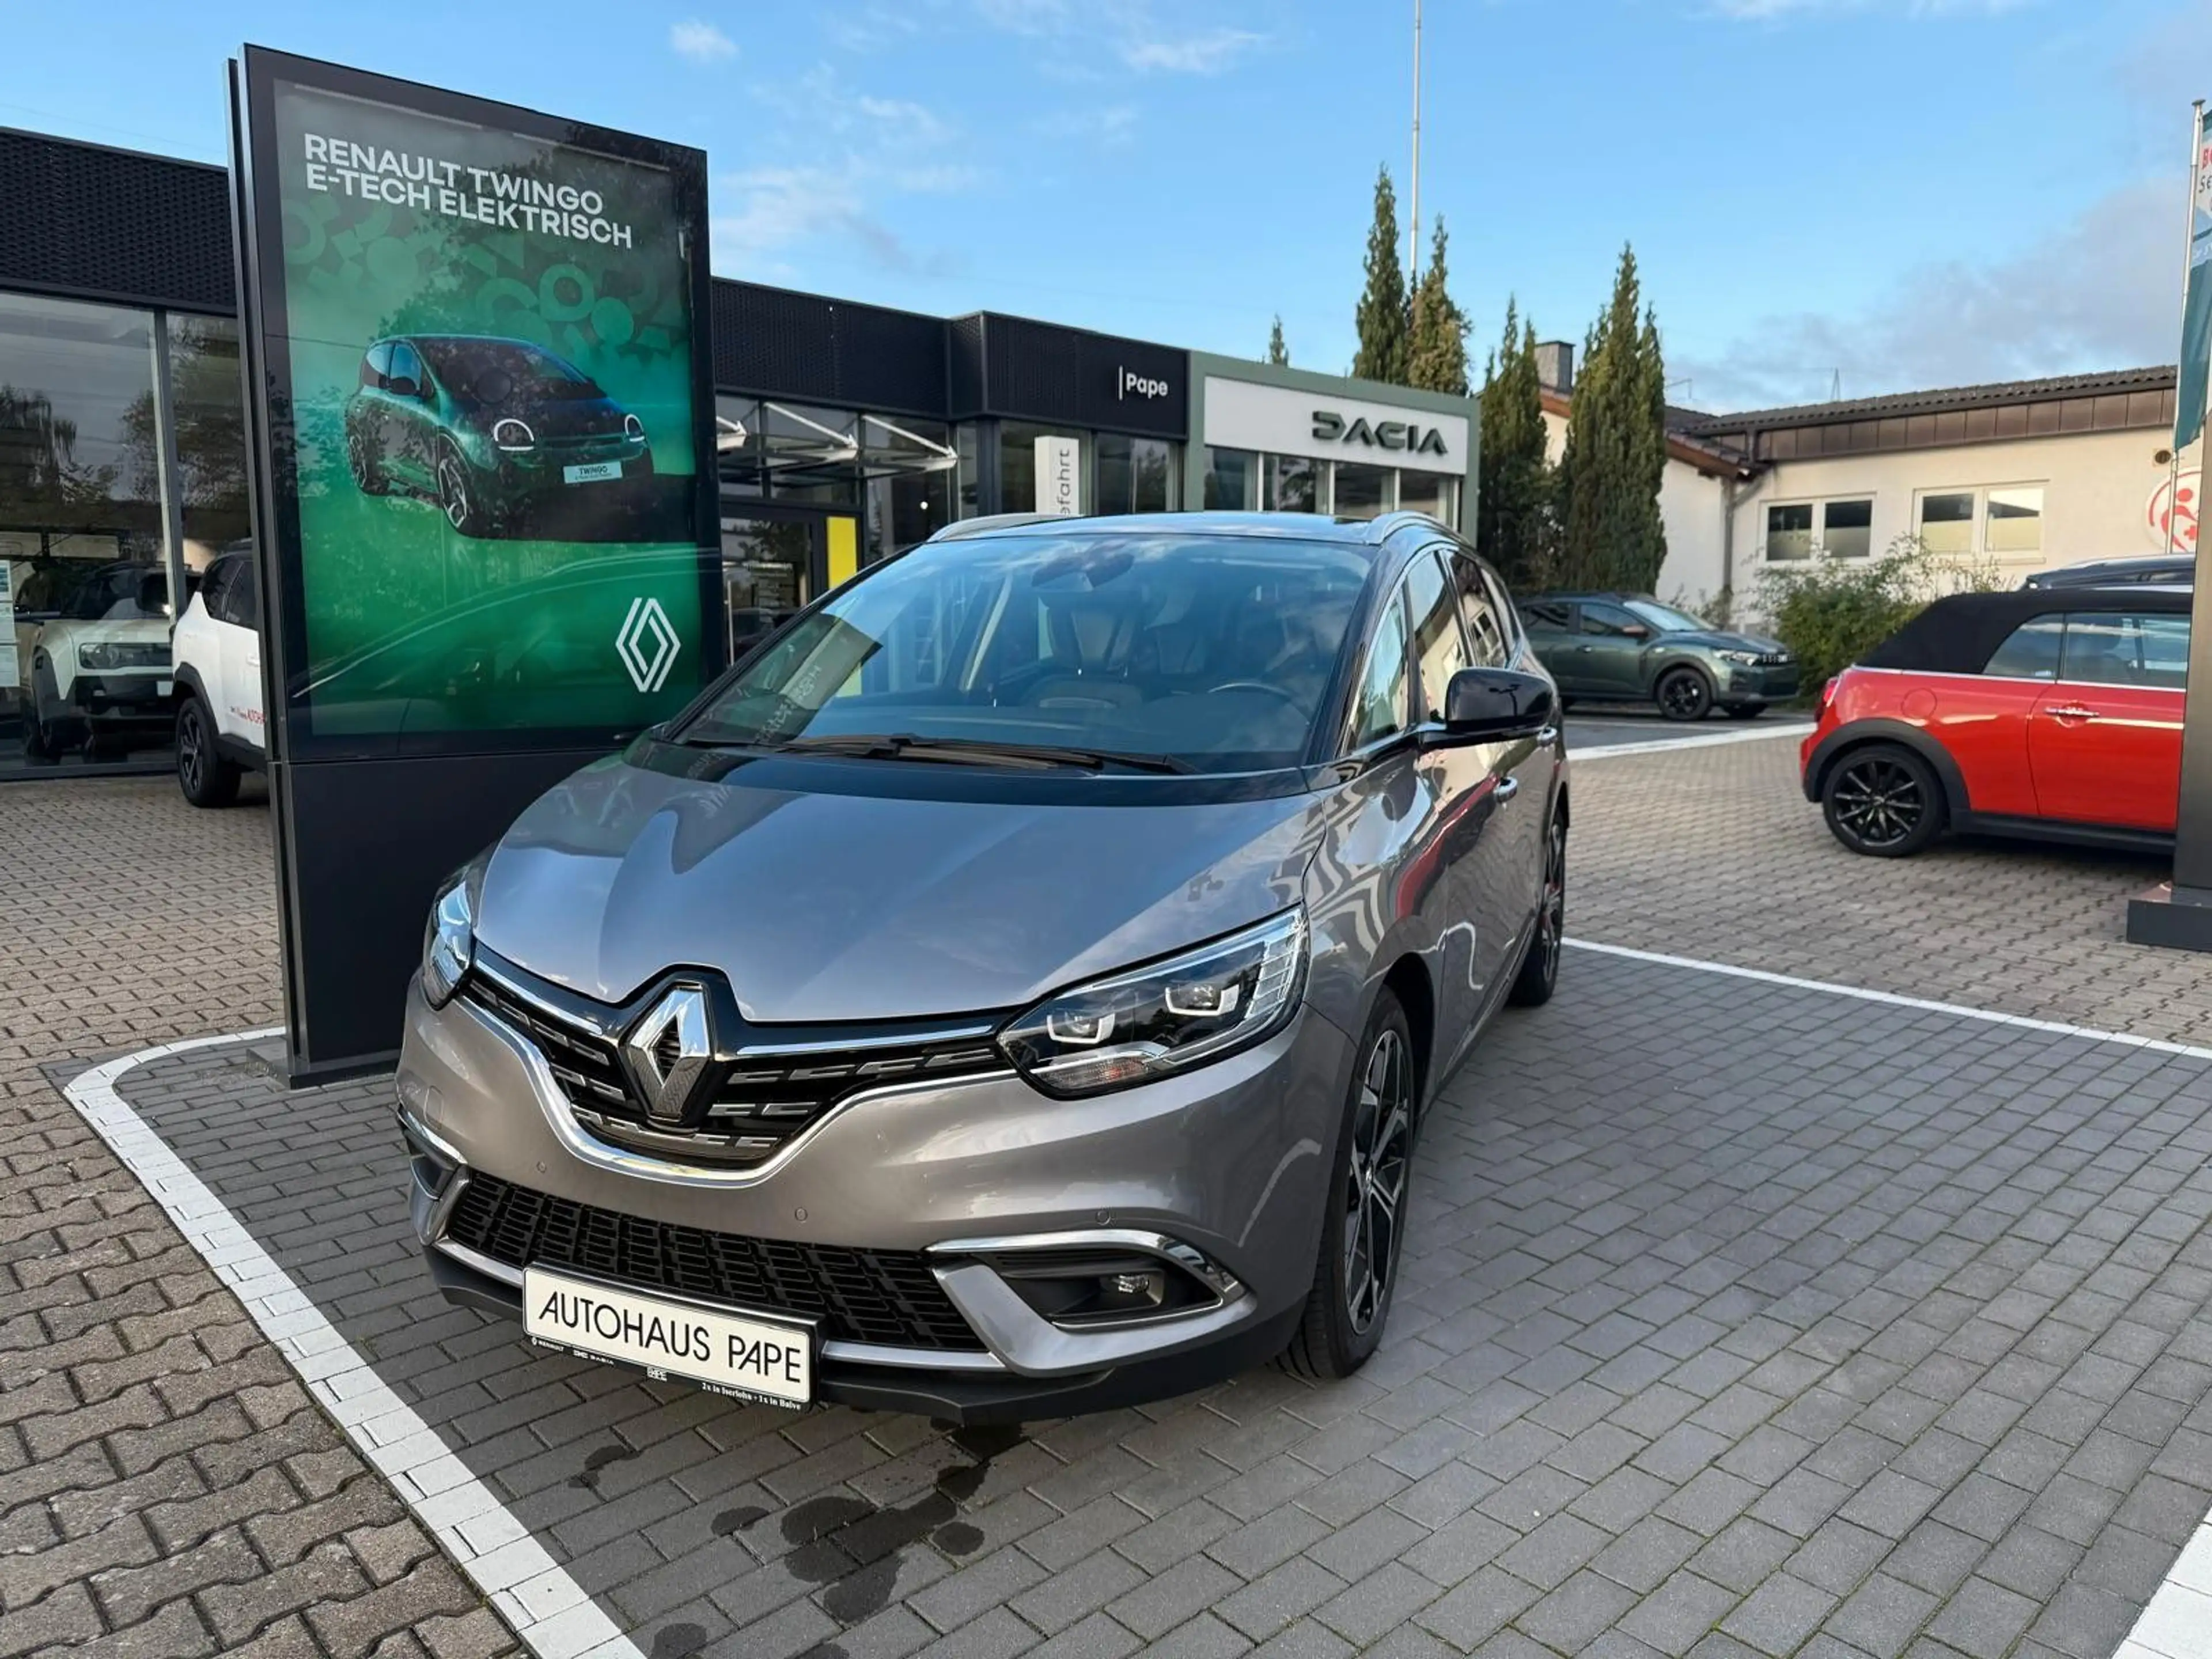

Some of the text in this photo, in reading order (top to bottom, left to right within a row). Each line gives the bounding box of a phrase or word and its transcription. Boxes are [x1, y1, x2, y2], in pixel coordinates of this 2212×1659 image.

[305, 133, 603, 215] RENAULT TWINGO
[306, 162, 632, 249] E-TECH ELEKTRISCH
[1126, 372, 1168, 399] Pape
[1312, 410, 1449, 457] DACIA
[539, 1291, 801, 1384] AUTOHAUS PAPE
